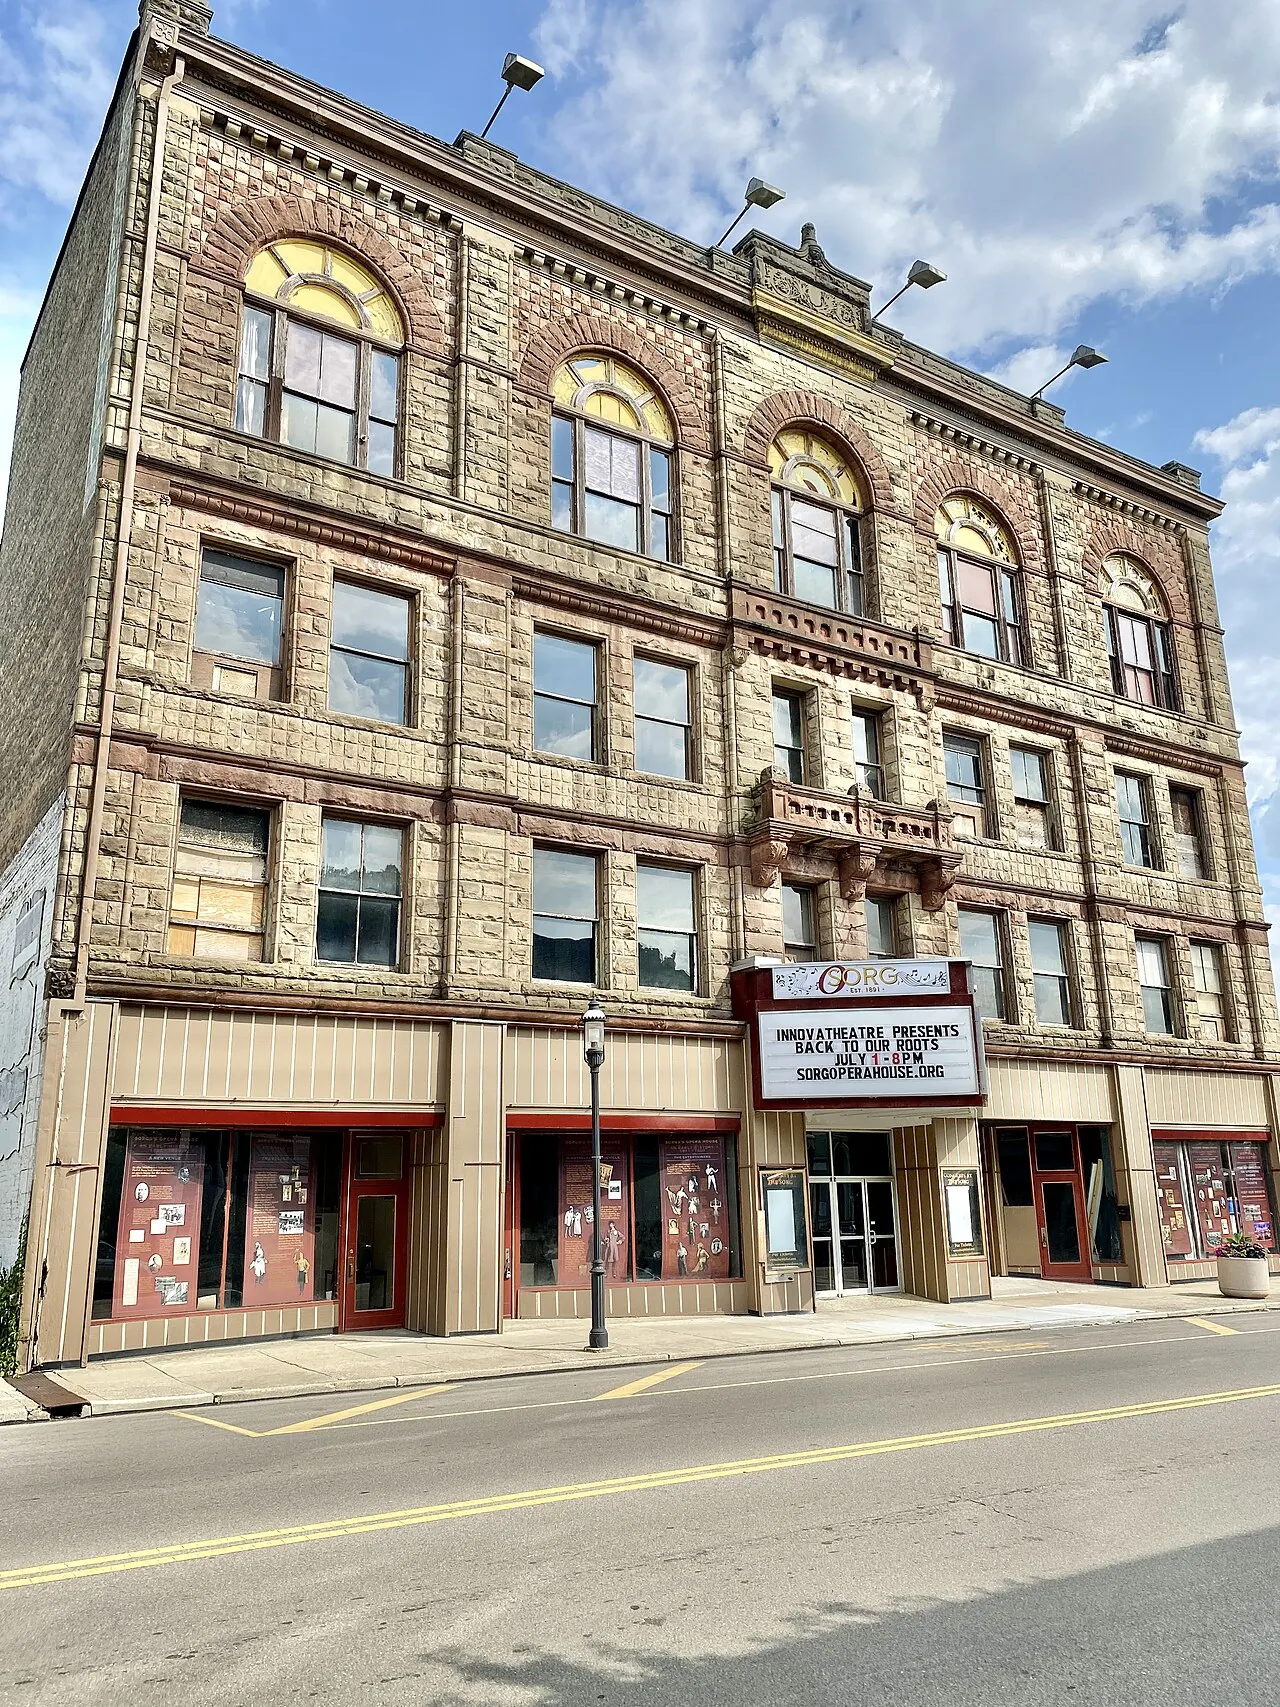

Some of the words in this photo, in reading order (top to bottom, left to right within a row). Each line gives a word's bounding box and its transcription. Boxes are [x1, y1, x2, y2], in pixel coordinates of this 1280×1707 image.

[828, 966, 898, 987] SORG
[776, 1026, 884, 1041] INNOVATHEATRE
[892, 1024, 959, 1039] PRESENTS
[795, 1041, 834, 1054] BACK
[842, 1040, 859, 1053] TO
[865, 1039, 890, 1052] OUR
[896, 1038, 939, 1052] ROOTS
[834, 1053, 866, 1066] JULY
[796, 1065, 945, 1081] SORGOPERAHOUSE.ORG
